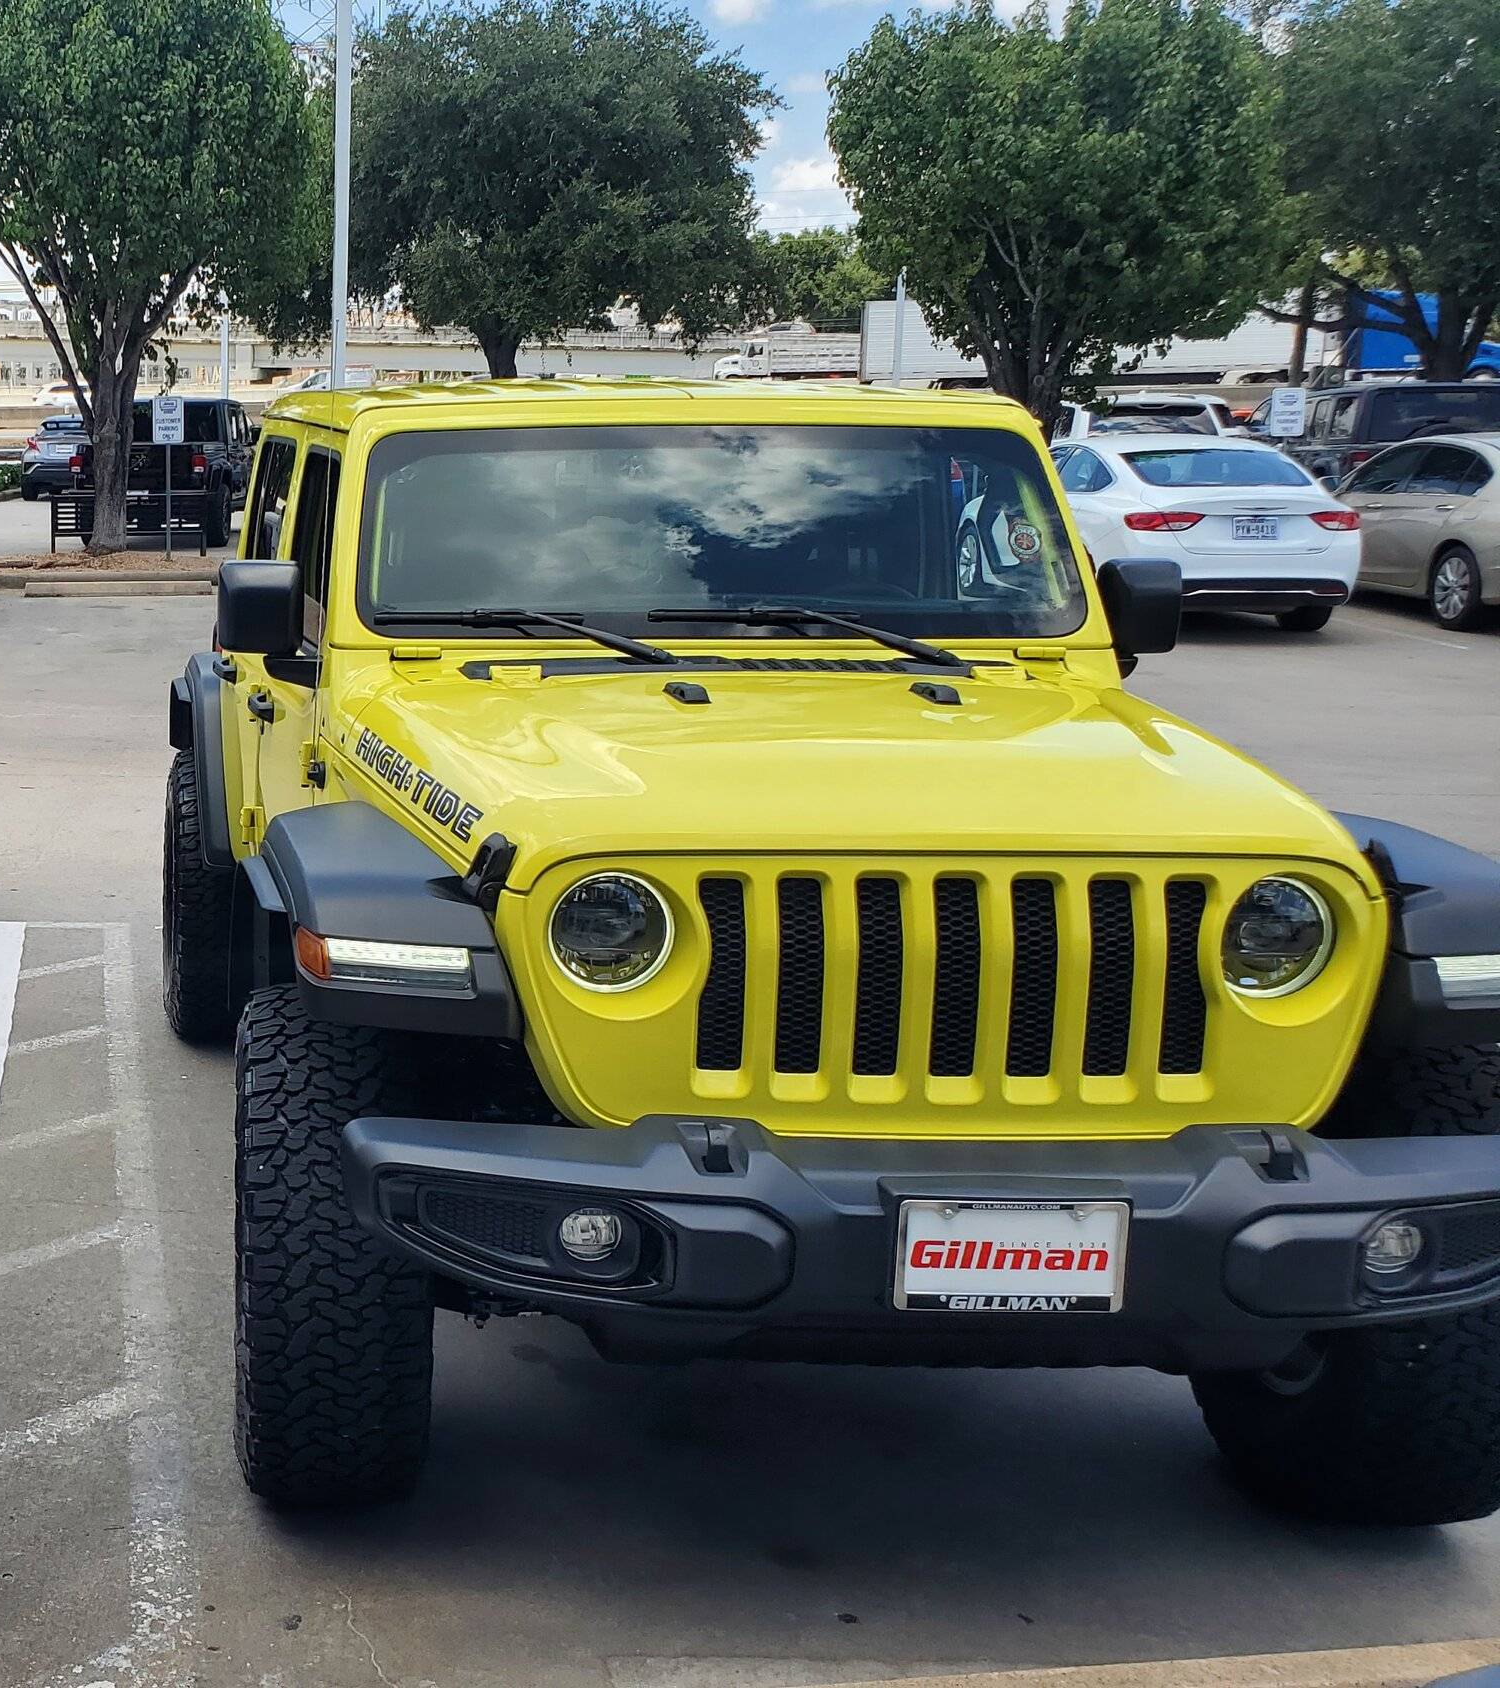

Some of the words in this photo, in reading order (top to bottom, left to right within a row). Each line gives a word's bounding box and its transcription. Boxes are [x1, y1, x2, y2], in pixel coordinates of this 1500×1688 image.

[410, 768, 484, 843] TIDE
[909, 1240, 1109, 1271] Gillman
[999, 1241, 1052, 1249] SINCE
[948, 1296, 1070, 1311] GILLMAN
